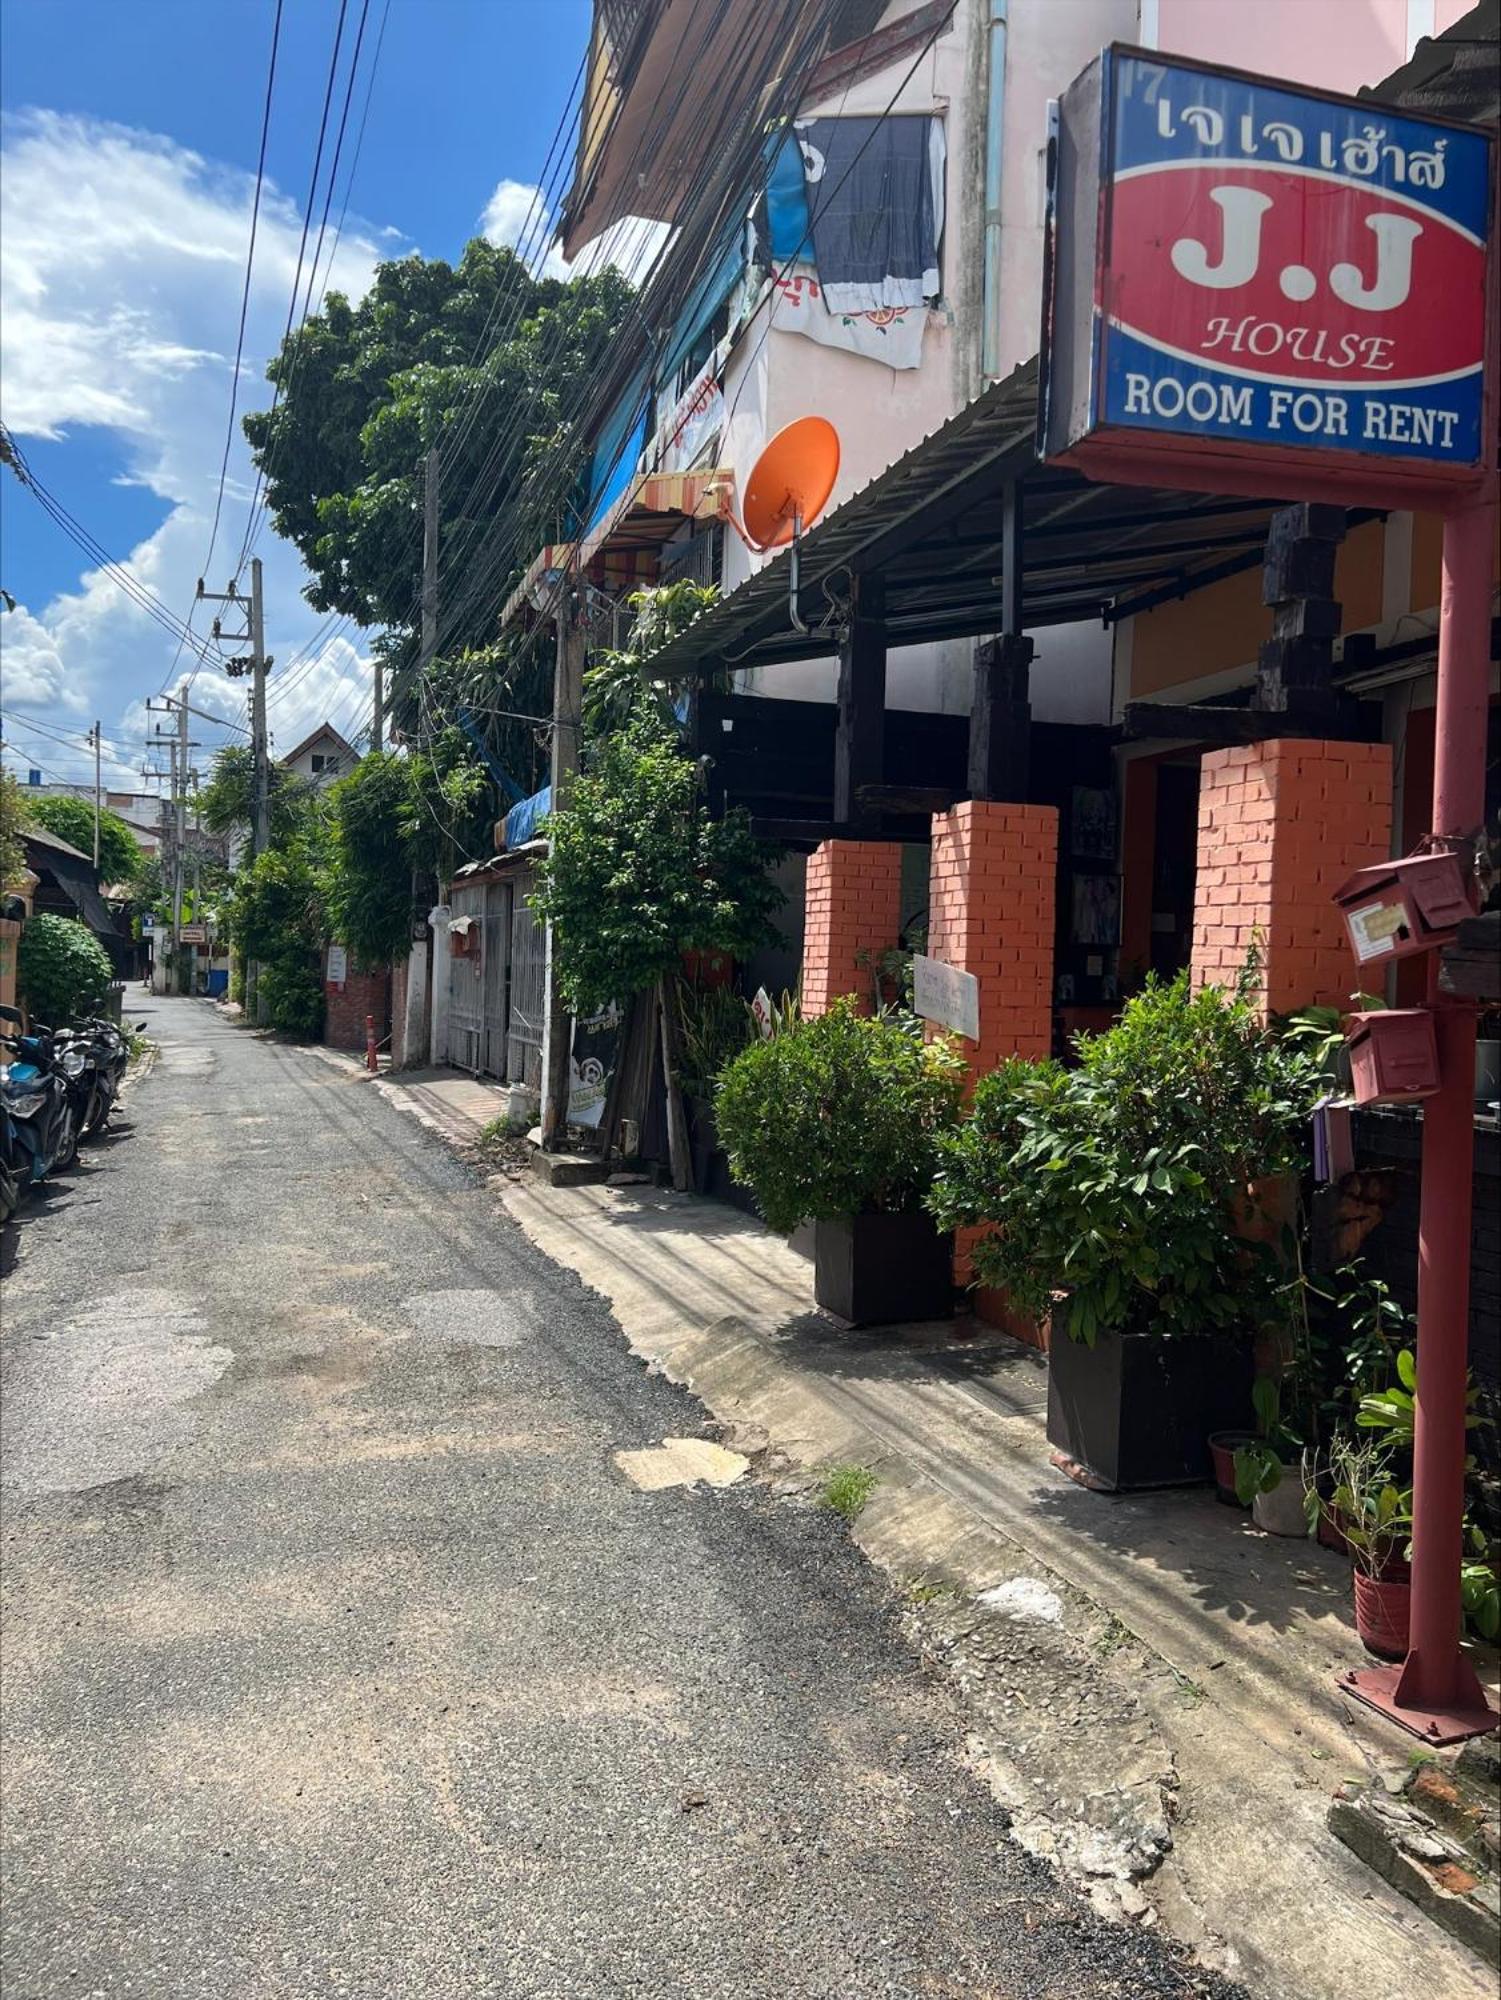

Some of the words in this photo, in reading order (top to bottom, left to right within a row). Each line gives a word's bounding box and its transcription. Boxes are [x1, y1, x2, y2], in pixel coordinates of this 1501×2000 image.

[1171, 185, 1424, 311] J.J
[1202, 316, 1395, 370] HOUSE
[1125, 373, 1254, 427] ROOM
[1268, 390, 1349, 435] FOR
[1363, 400, 1459, 448] RENT
